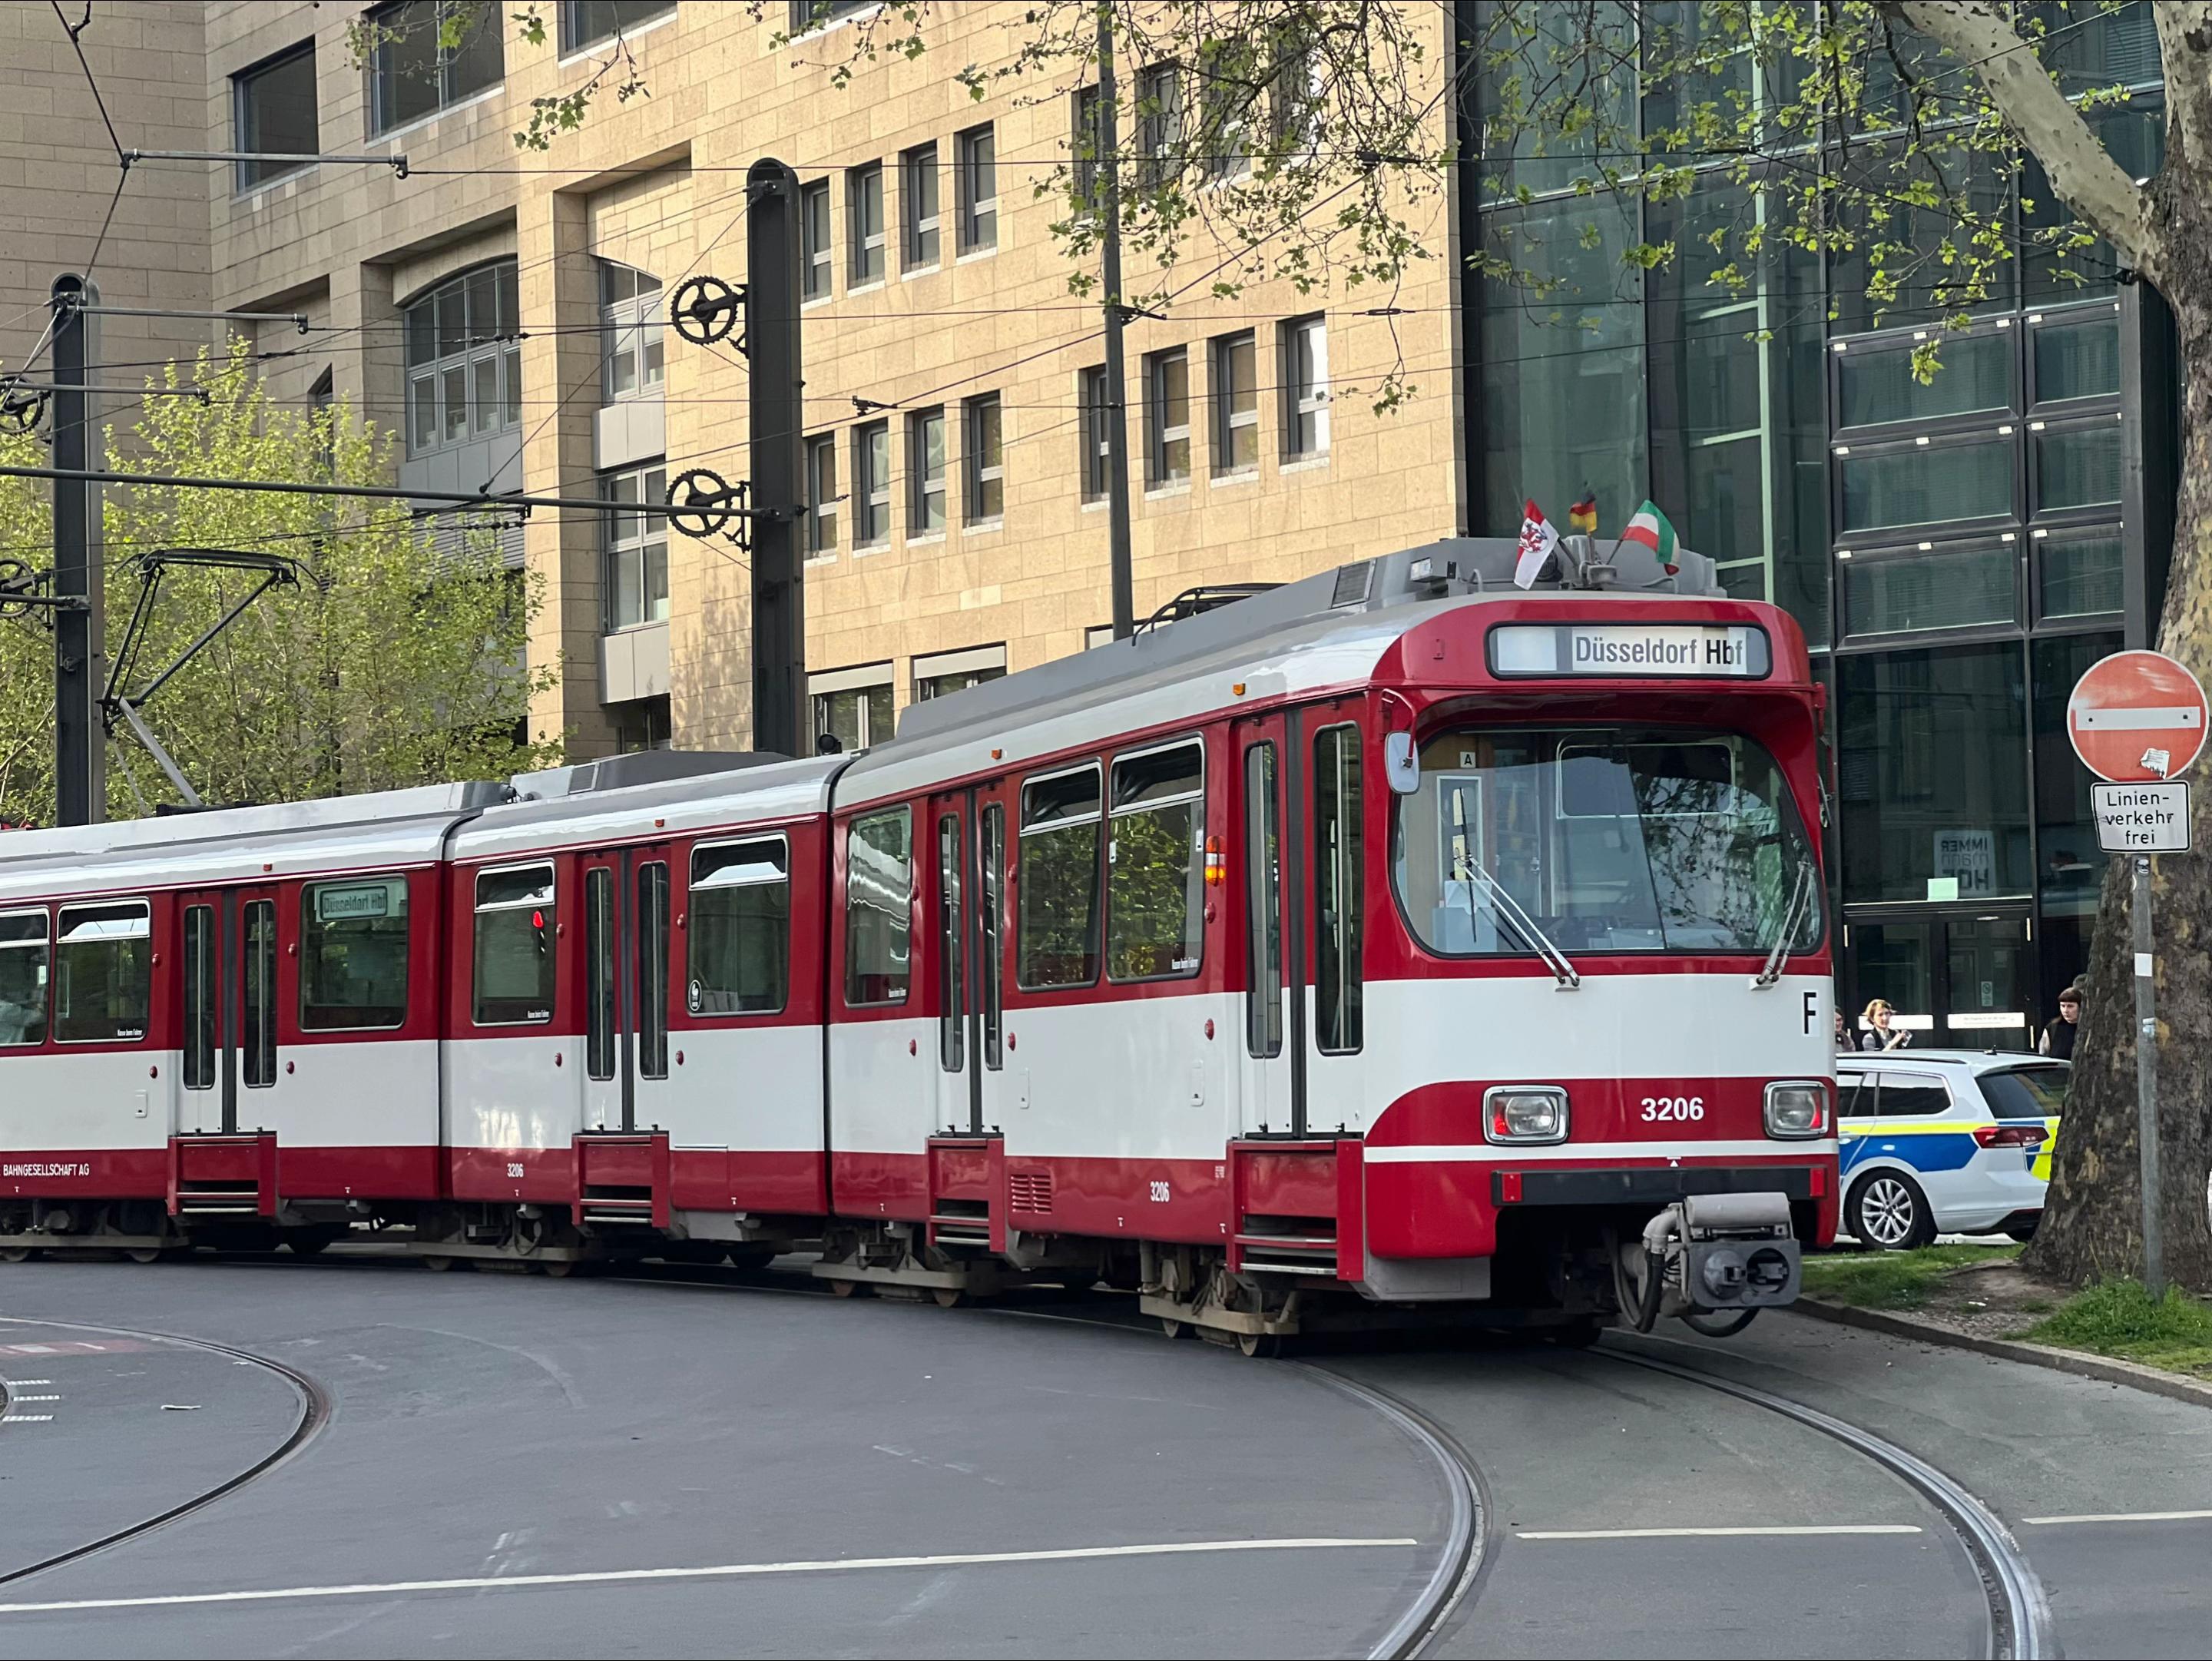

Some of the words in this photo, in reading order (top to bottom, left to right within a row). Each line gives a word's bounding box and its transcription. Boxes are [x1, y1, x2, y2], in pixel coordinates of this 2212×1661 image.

[1575, 637, 1697, 664] Düsseldorf
[1705, 639, 1743, 665] Hbf
[1464, 754, 1472, 765] A
[2107, 791, 2169, 807] Linien-
[2105, 810, 2174, 825] verkehr
[2125, 830, 2154, 844] frei
[1803, 992, 1817, 1035] F
[1641, 1097, 1704, 1122] 3206
[3, 1163, 78, 1177] BAHNGESELLSCHAFT
[78, 1163, 90, 1176] AG
[507, 1162, 524, 1178] 3206
[1151, 1181, 1170, 1202] 3206
